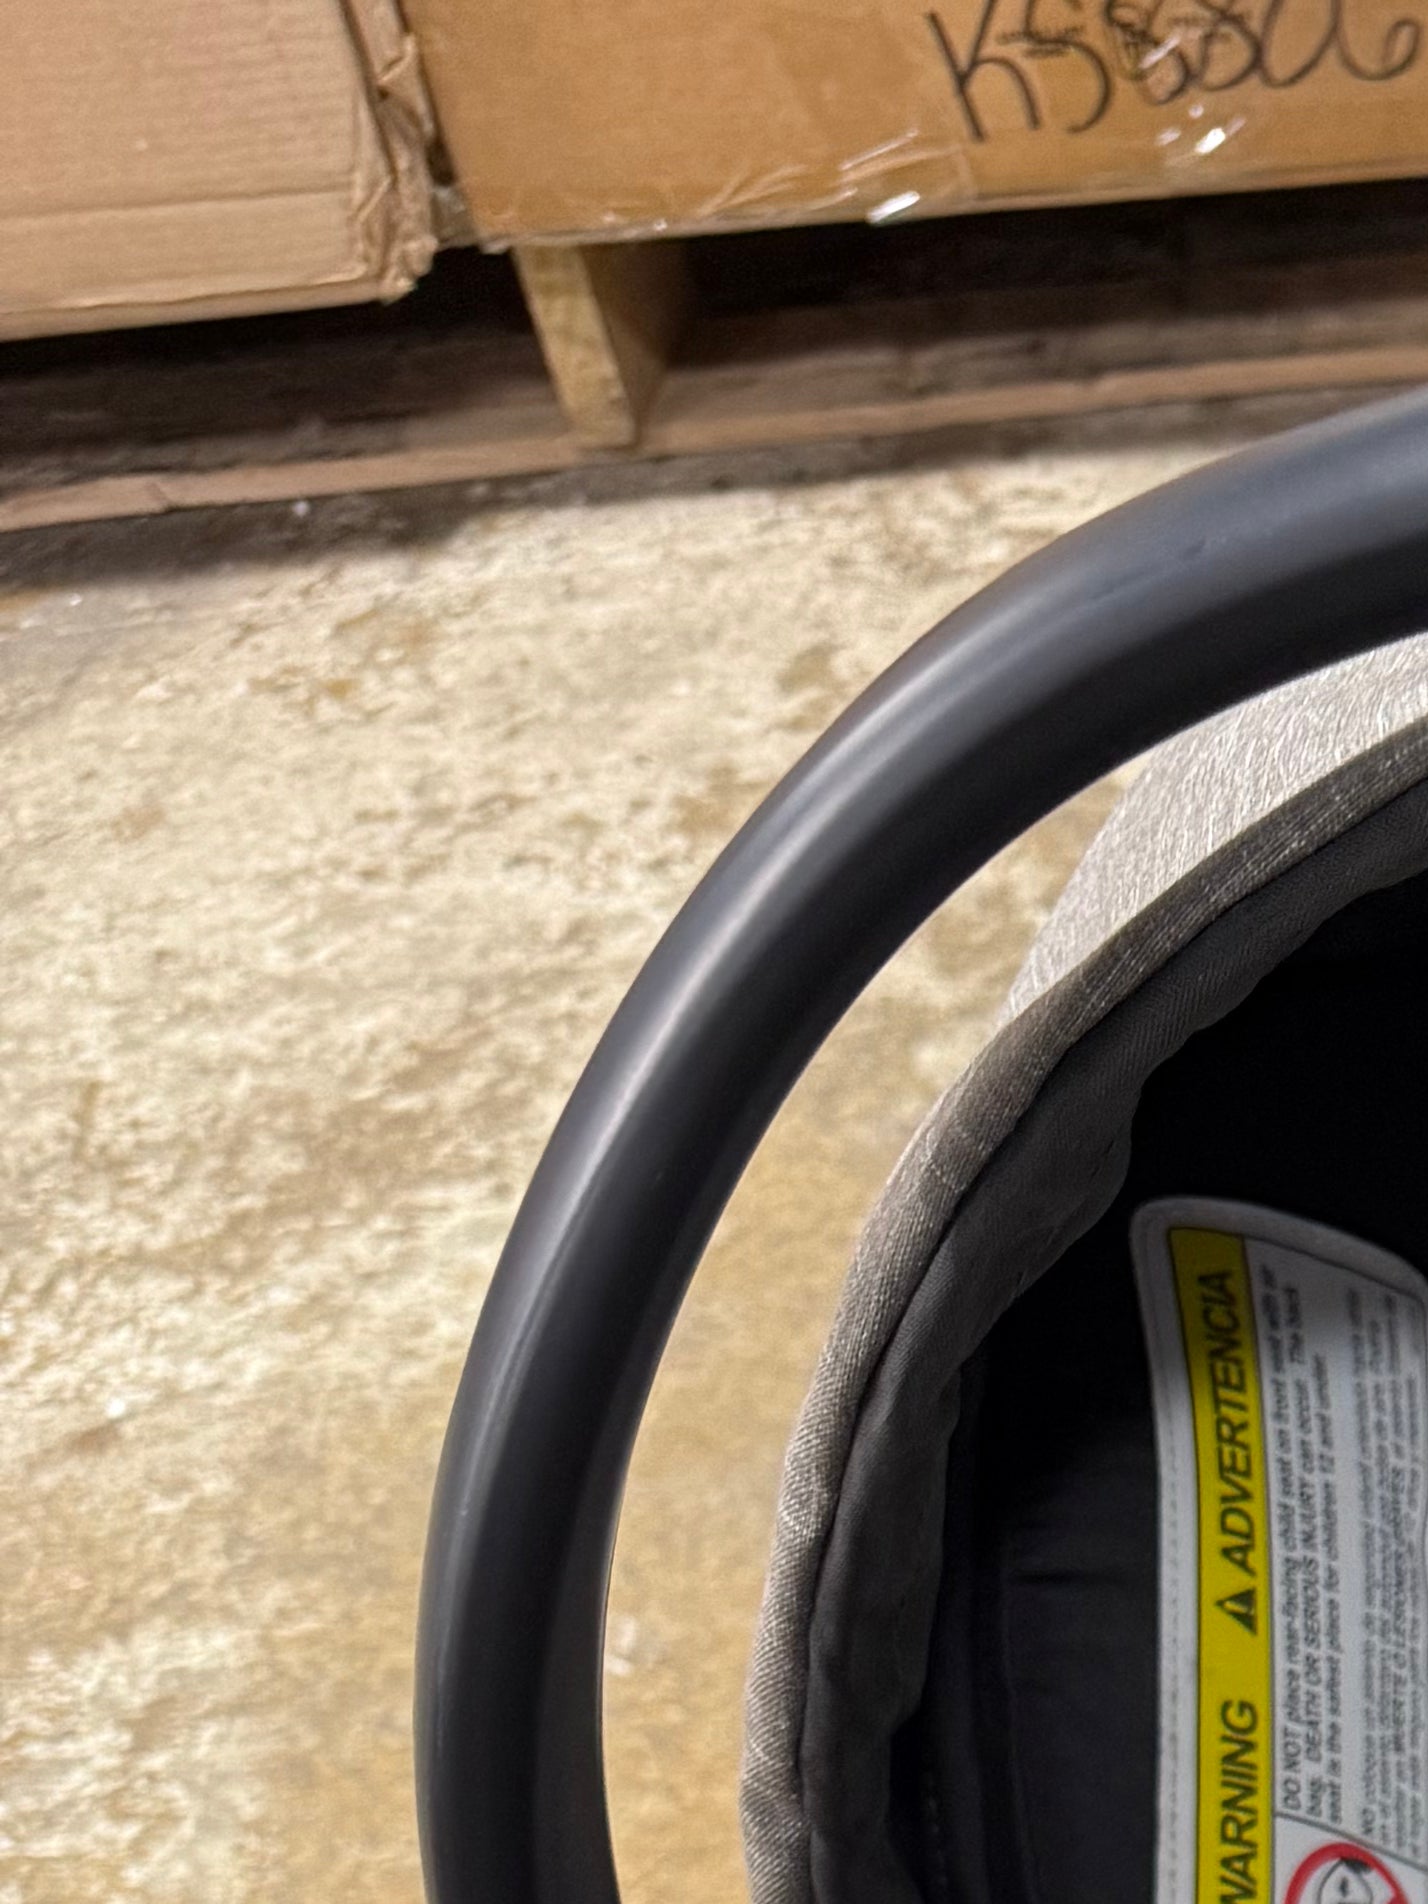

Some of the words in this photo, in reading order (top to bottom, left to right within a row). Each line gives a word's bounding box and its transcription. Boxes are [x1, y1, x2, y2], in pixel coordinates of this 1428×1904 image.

[1200, 1272, 1258, 1575] ADVERTENCIA
[1297, 1477, 1318, 1551] INJURY
[1303, 1556, 1318, 1650] SERIOUS
[1303, 1652, 1320, 1686] OR
[1283, 1726, 1299, 1772] NOT
[1304, 1689, 1319, 1762] DEATH
[1283, 1778, 1299, 1810] DO
